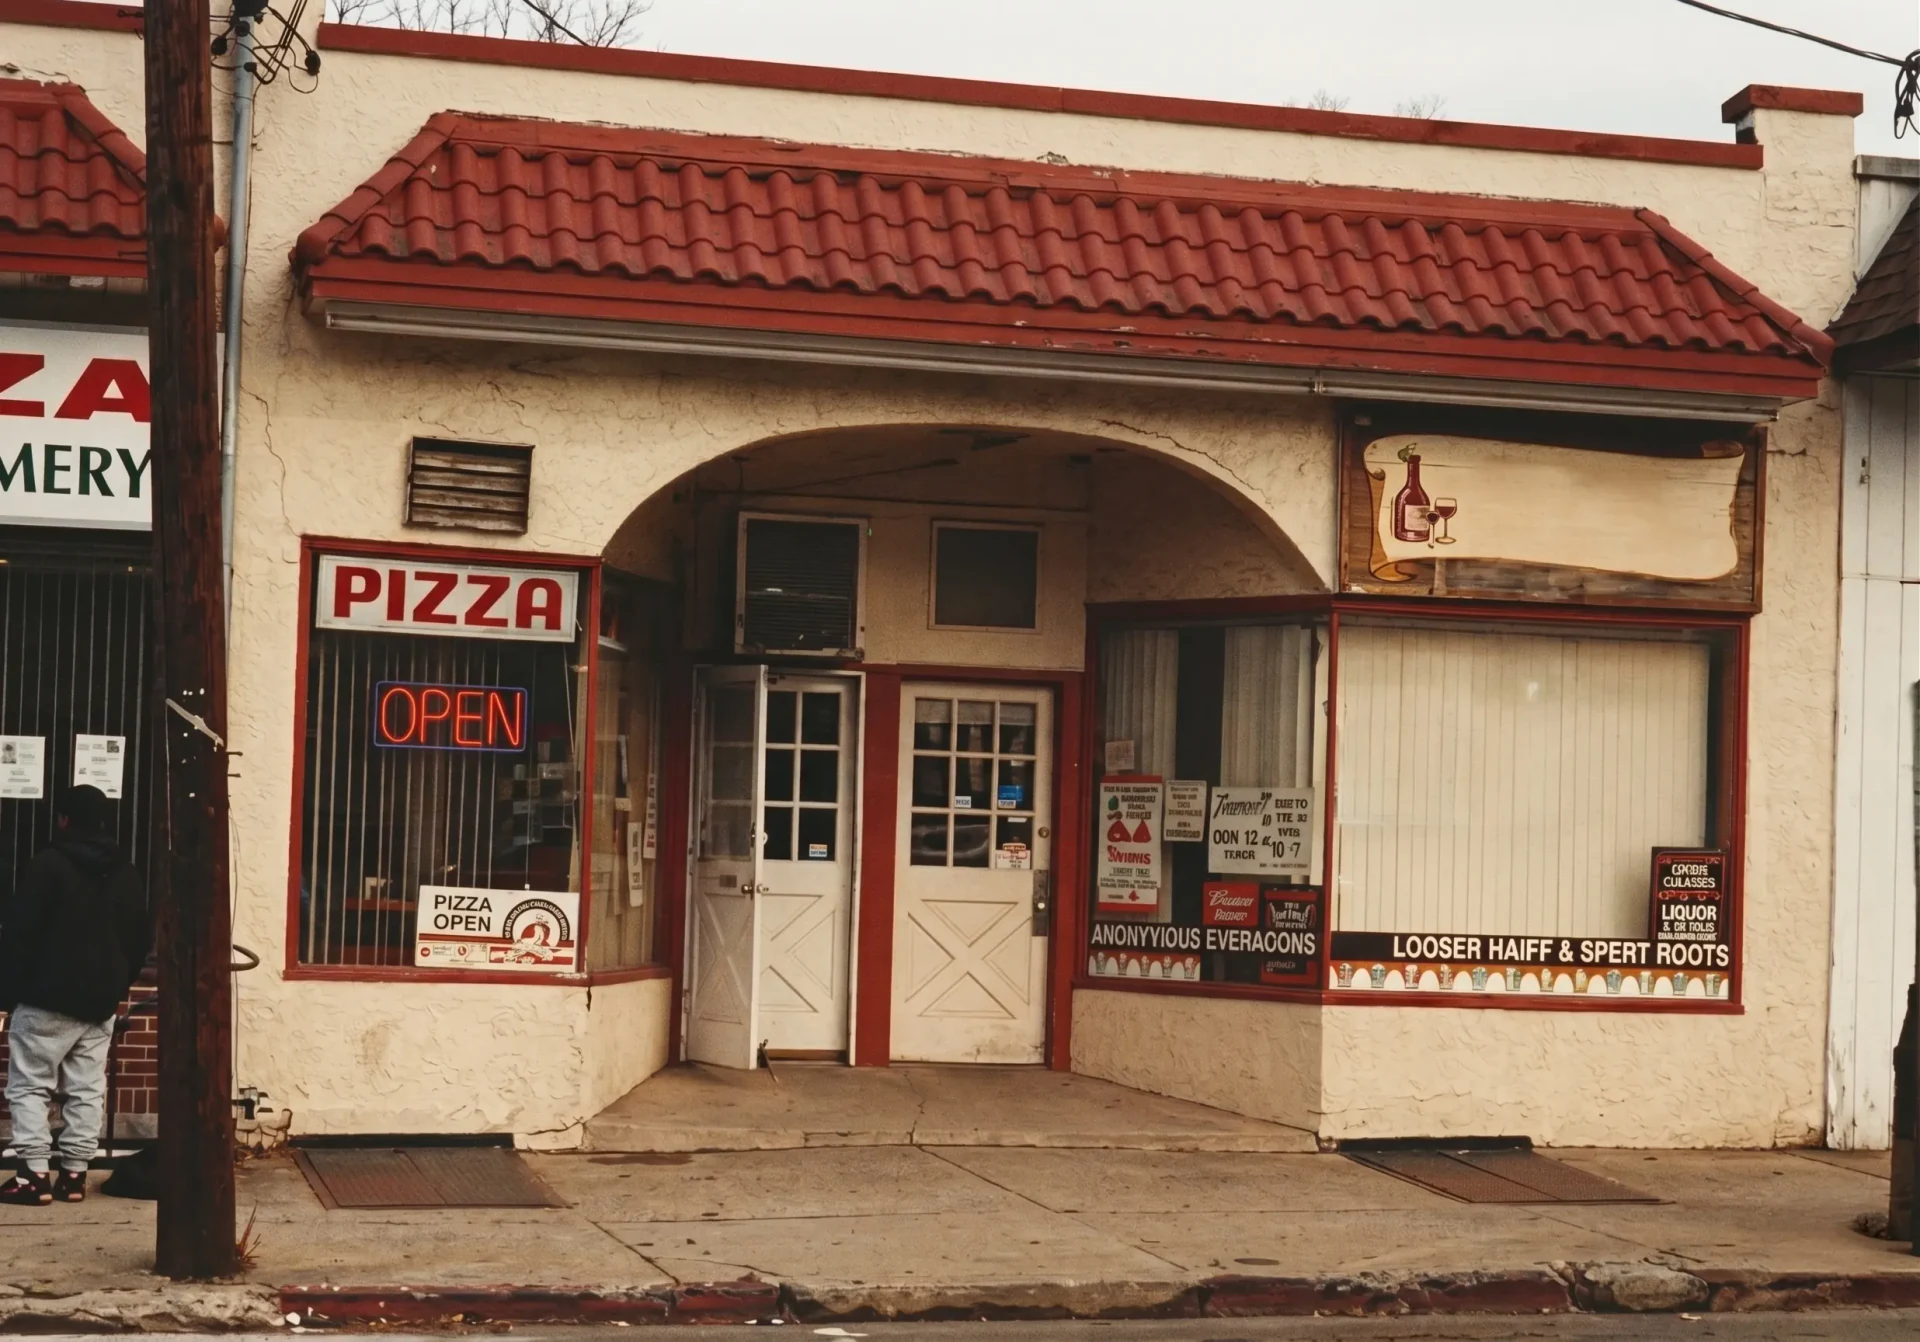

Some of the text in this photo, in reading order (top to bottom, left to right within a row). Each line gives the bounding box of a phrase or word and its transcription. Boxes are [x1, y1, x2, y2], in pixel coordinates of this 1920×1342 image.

[334, 565, 562, 630] PIZZA
[380, 687, 522, 746] OPEN
[1244, 830, 1258, 845] 12
[434, 894, 492, 913] PIZZA
[1662, 904, 1717, 921] LIQUOR
[434, 914, 491, 932] OPEN
[1393, 935, 1729, 967] LOOSER HAIFF & SPERT ROOTS
